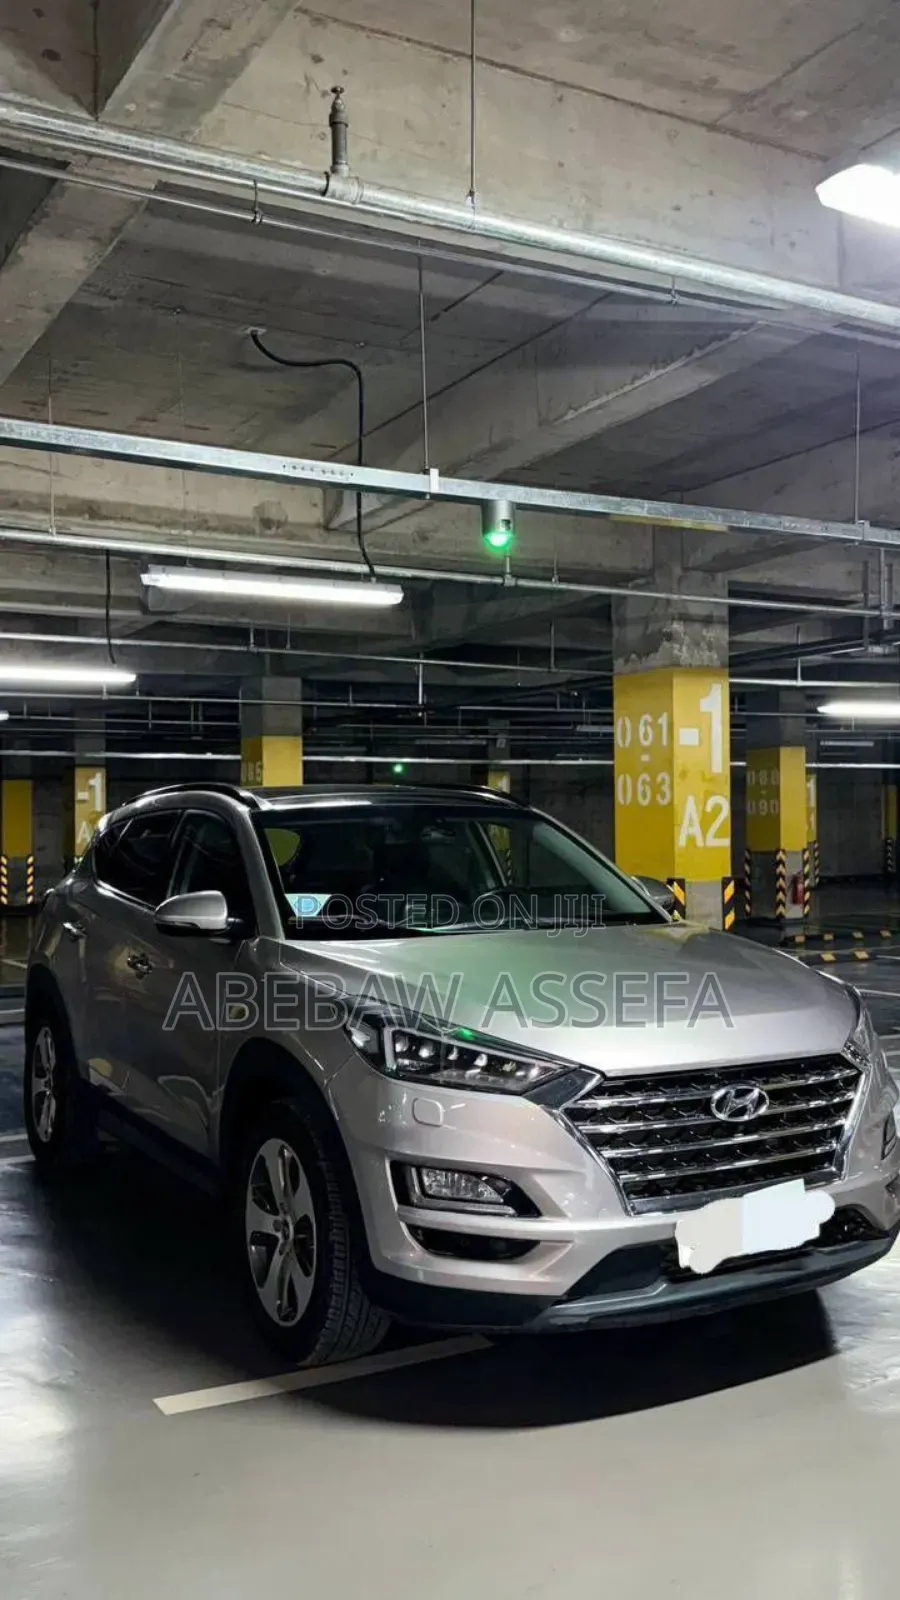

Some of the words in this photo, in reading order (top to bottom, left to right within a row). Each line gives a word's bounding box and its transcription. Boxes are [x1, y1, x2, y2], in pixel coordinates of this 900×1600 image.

[616, 712, 669, 748] 061
[679, 683, 722, 773] -1
[77, 772, 101, 812] -1
[617, 772, 671, 806] 063
[678, 795, 731, 848] A2
